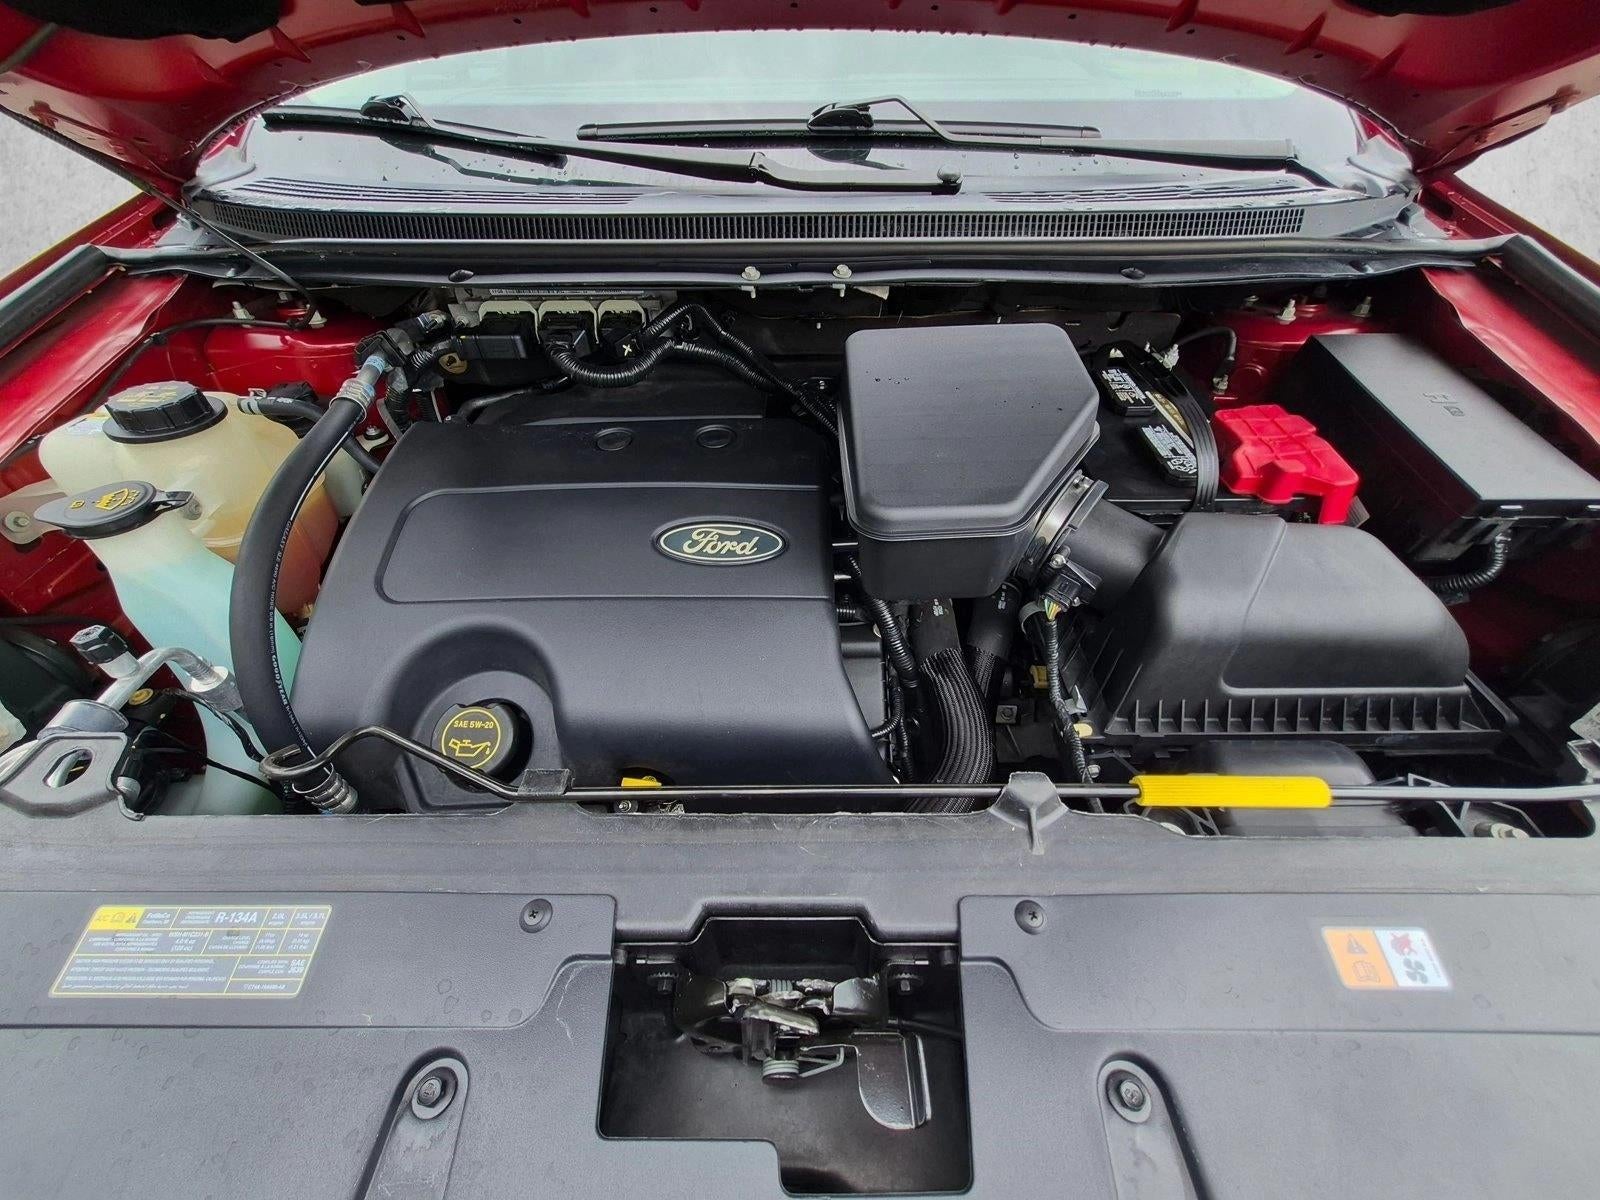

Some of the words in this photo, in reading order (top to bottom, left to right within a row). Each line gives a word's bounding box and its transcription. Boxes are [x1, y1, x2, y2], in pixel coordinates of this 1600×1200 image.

[682, 528, 760, 555] Ford
[272, 654, 288, 706] GOODYEAR
[453, 720, 468, 728] SAE
[469, 721, 494, 729] 5W-20
[215, 911, 258, 923] R-134A
